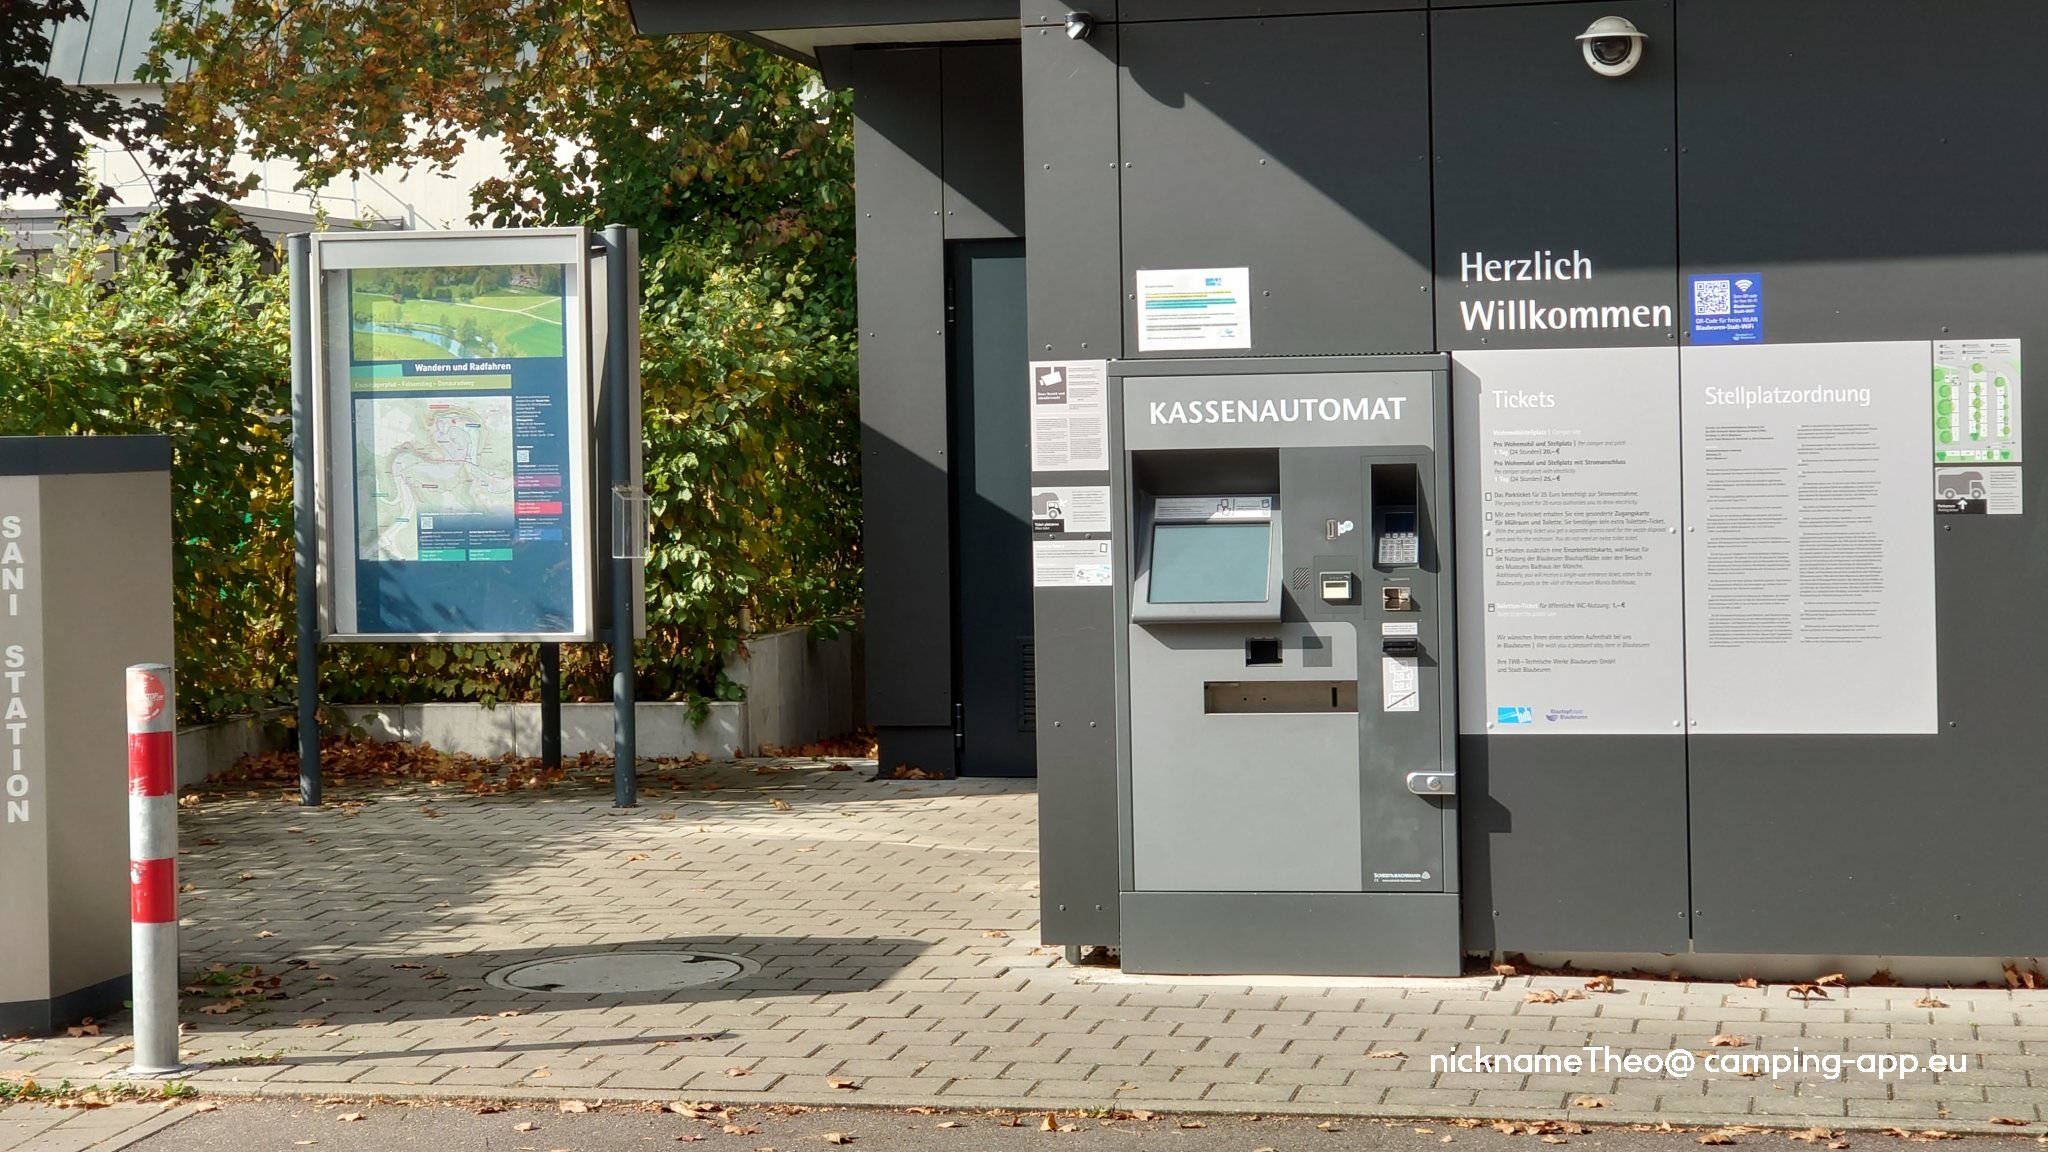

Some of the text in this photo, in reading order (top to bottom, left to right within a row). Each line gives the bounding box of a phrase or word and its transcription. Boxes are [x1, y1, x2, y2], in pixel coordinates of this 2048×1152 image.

[1461, 250, 1592, 282] Herzlich
[1460, 299, 1672, 331] Willkommen
[415, 362, 512, 372] Wandern und Radfahren
[1150, 397, 1406, 425] KASSENAUTOMAT
[1492, 390, 1556, 408] Tickets
[1705, 385, 1870, 409] Stellplatzordnung
[1, 515, 30, 823] SANI STATION
